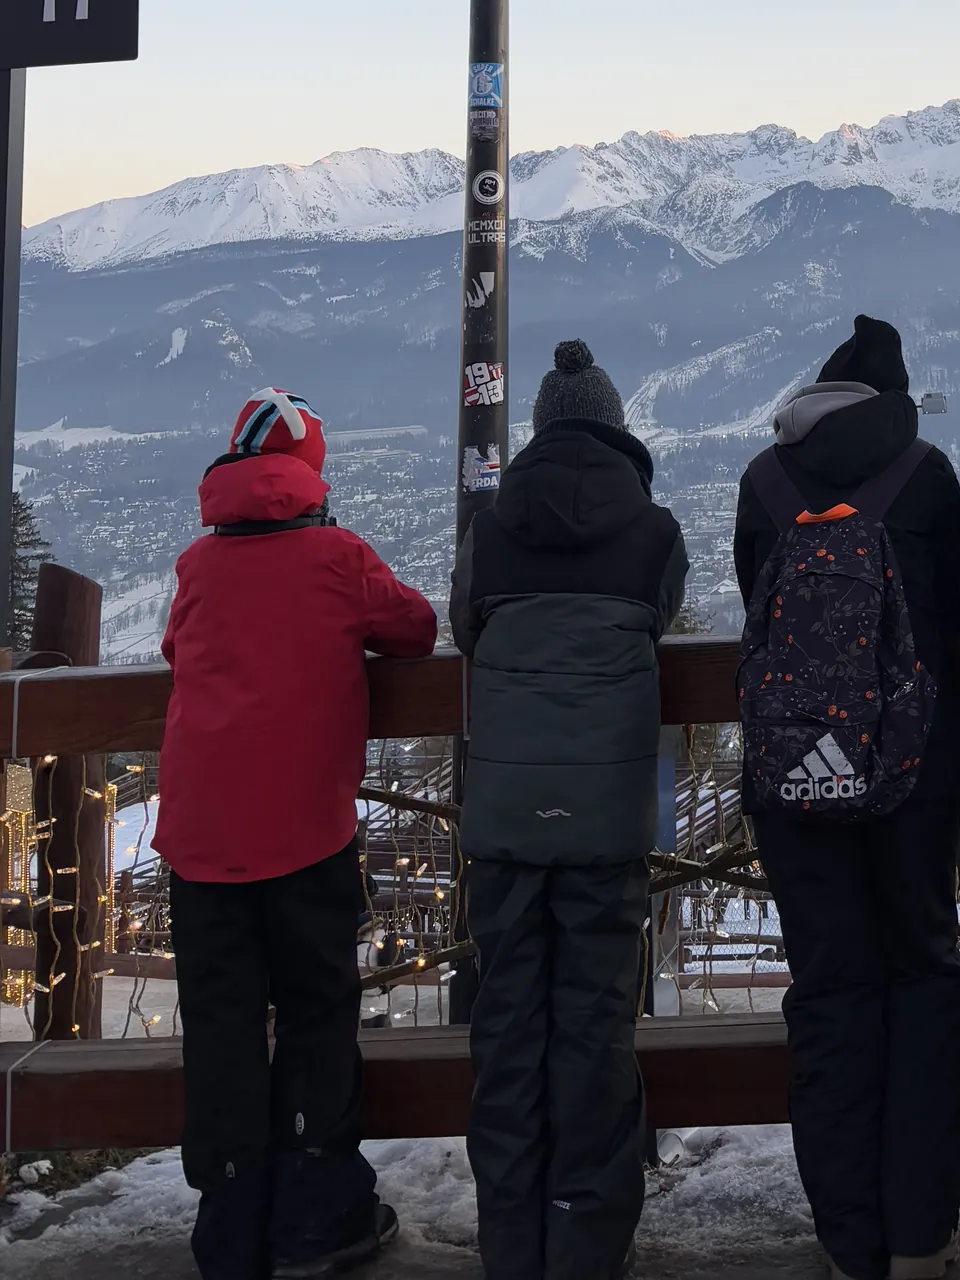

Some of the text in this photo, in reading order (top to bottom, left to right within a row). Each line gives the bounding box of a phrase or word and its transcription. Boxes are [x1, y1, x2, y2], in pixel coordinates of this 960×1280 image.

[470, 97, 495, 106] SCHALKE
[468, 232, 506, 243] ULTRAS
[465, 363, 490, 387] 19
[478, 381, 503, 405] 13
[780, 772, 867, 801] adidas
